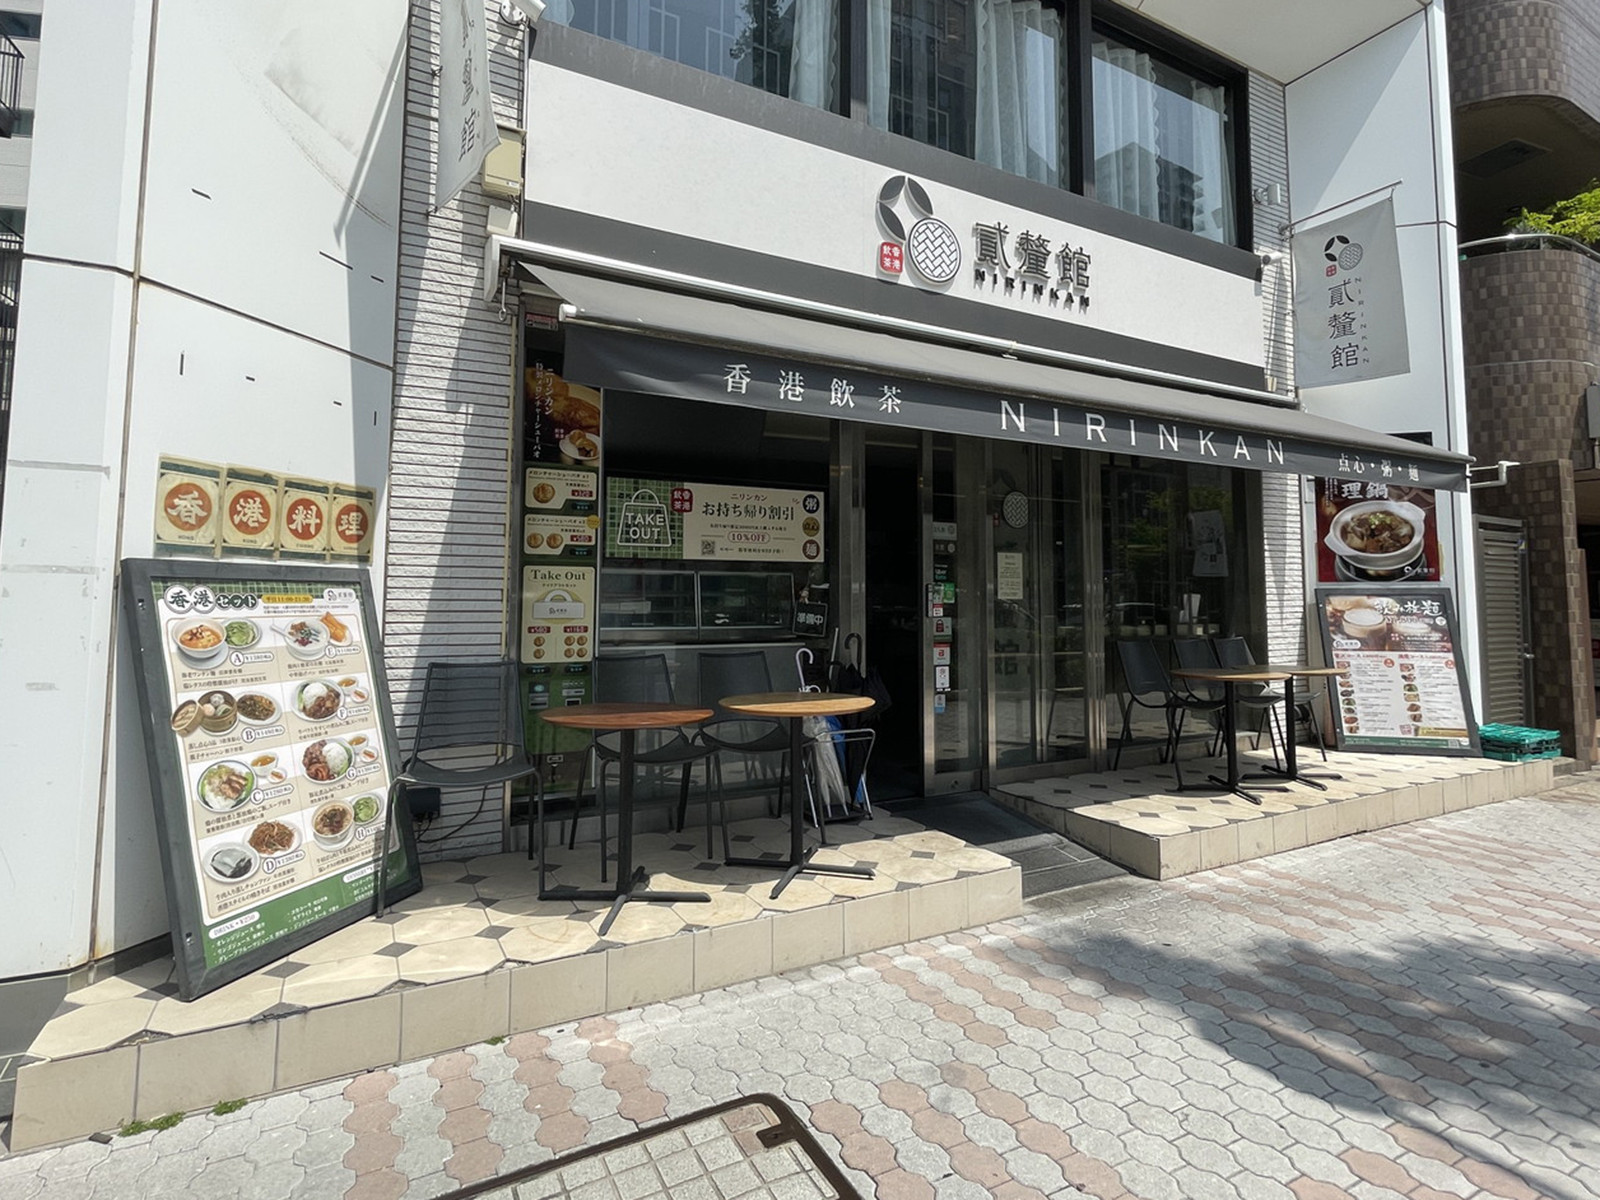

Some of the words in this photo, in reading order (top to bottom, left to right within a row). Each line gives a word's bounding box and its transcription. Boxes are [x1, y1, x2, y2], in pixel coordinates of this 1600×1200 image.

[975, 221, 1092, 289] 貳釐館
[975, 268, 1091, 308] NIRINKAN
[1327, 279, 1360, 370] 貳釐館
[1354, 277, 1371, 364] NIRINKAN
[723, 363, 903, 414] 香港飲茶
[1000, 400, 1285, 465] NIRINKAN
[730, 493, 768, 502] ニリンカン
[1341, 482, 1389, 499] 理鍋
[167, 490, 366, 536] 香港料理
[702, 501, 795, 521] お持ち帰り割引
[625, 512, 665, 527] TAKE
[629, 526, 661, 540] OUT
[531, 569, 562, 581] Take
[565, 571, 586, 581] Out
[169, 590, 256, 608] 香港セット
[234, 653, 242, 663] A
[327, 647, 335, 656] E
[339, 709, 346, 718] F
[245, 730, 253, 740] B
[348, 768, 355, 778] G
[253, 792, 262, 802] C
[266, 860, 274, 872] D
